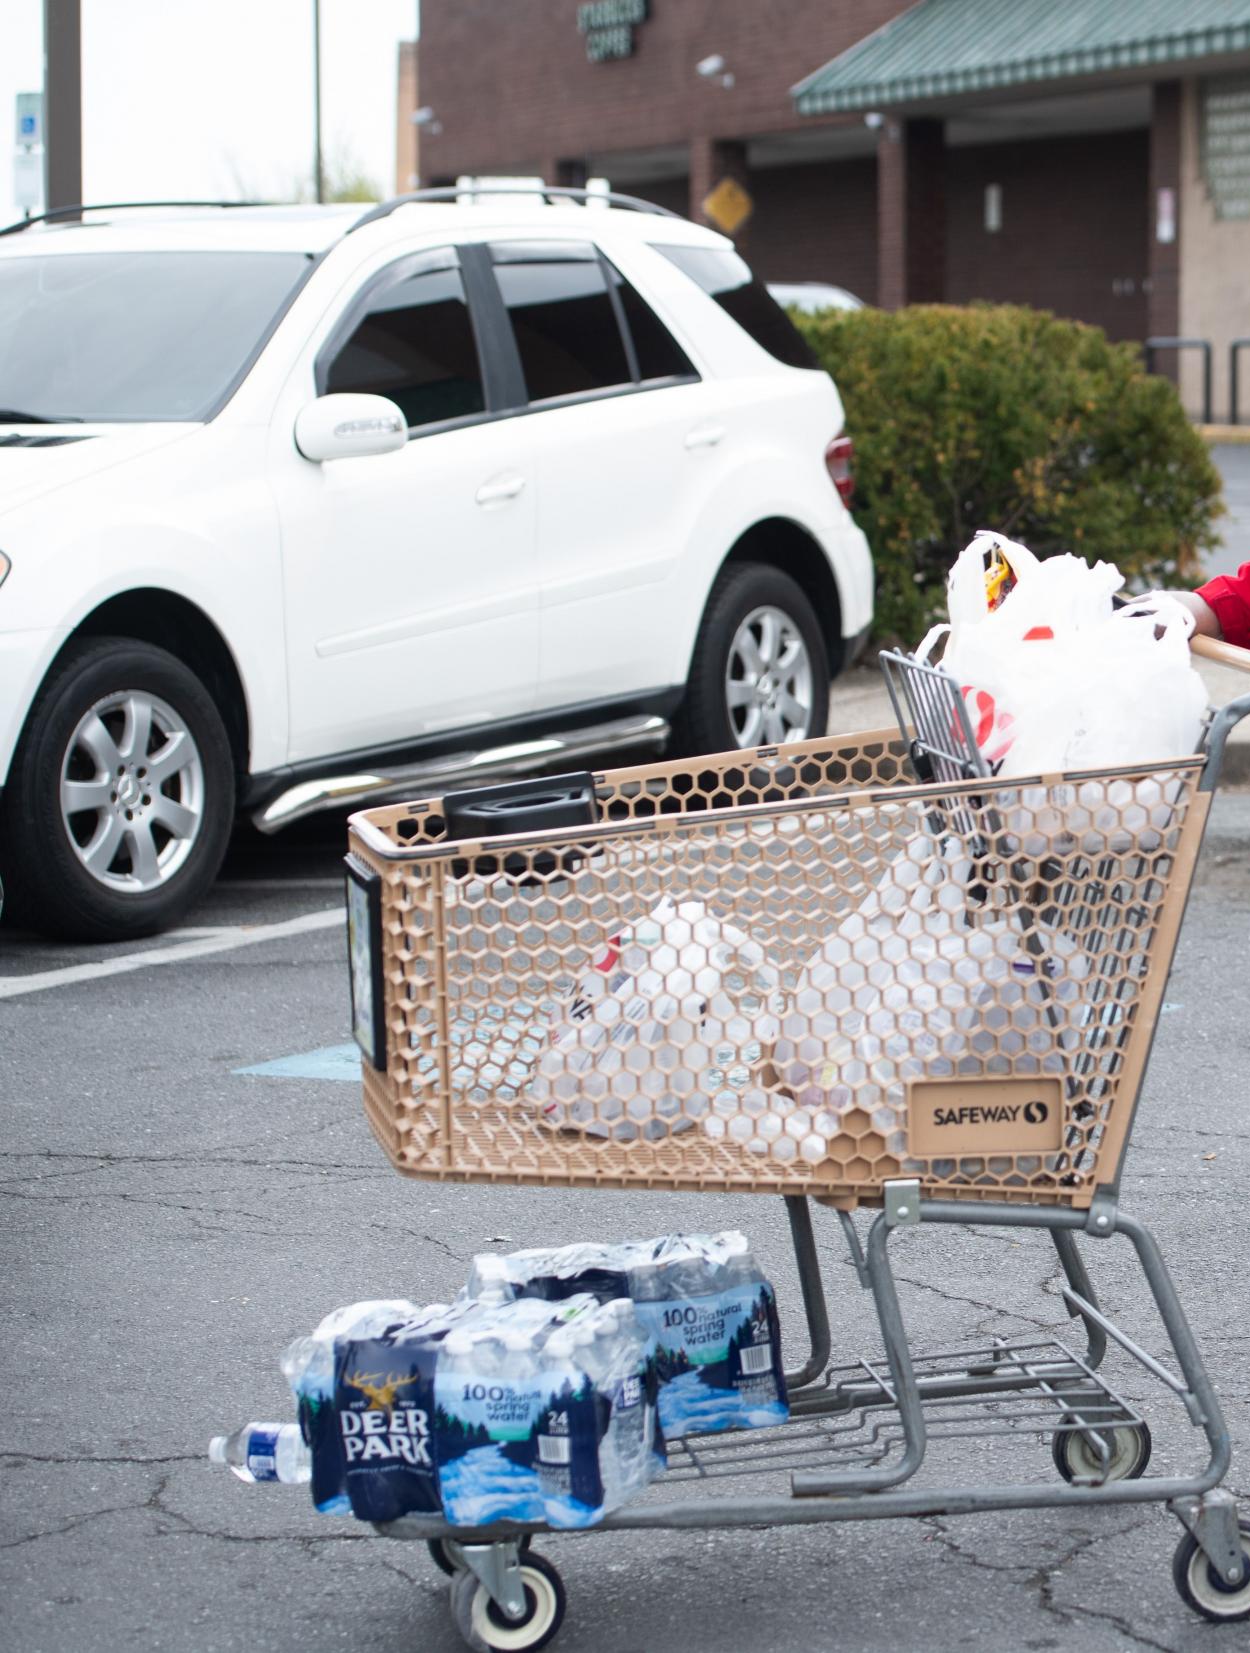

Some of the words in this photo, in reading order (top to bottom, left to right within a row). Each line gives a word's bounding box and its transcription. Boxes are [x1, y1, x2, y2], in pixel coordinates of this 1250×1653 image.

[934, 1105, 1021, 1126] SAFEWAY
[699, 1303, 742, 1322] natural
[683, 1319, 725, 1336] spring
[752, 1321, 769, 1335] 24
[685, 1330, 725, 1346] water
[486, 1402, 530, 1413] spring
[487, 1411, 529, 1421] water
[340, 1409, 429, 1436] DEER
[548, 1410, 568, 1427] 24
[344, 1434, 432, 1466] PARK
